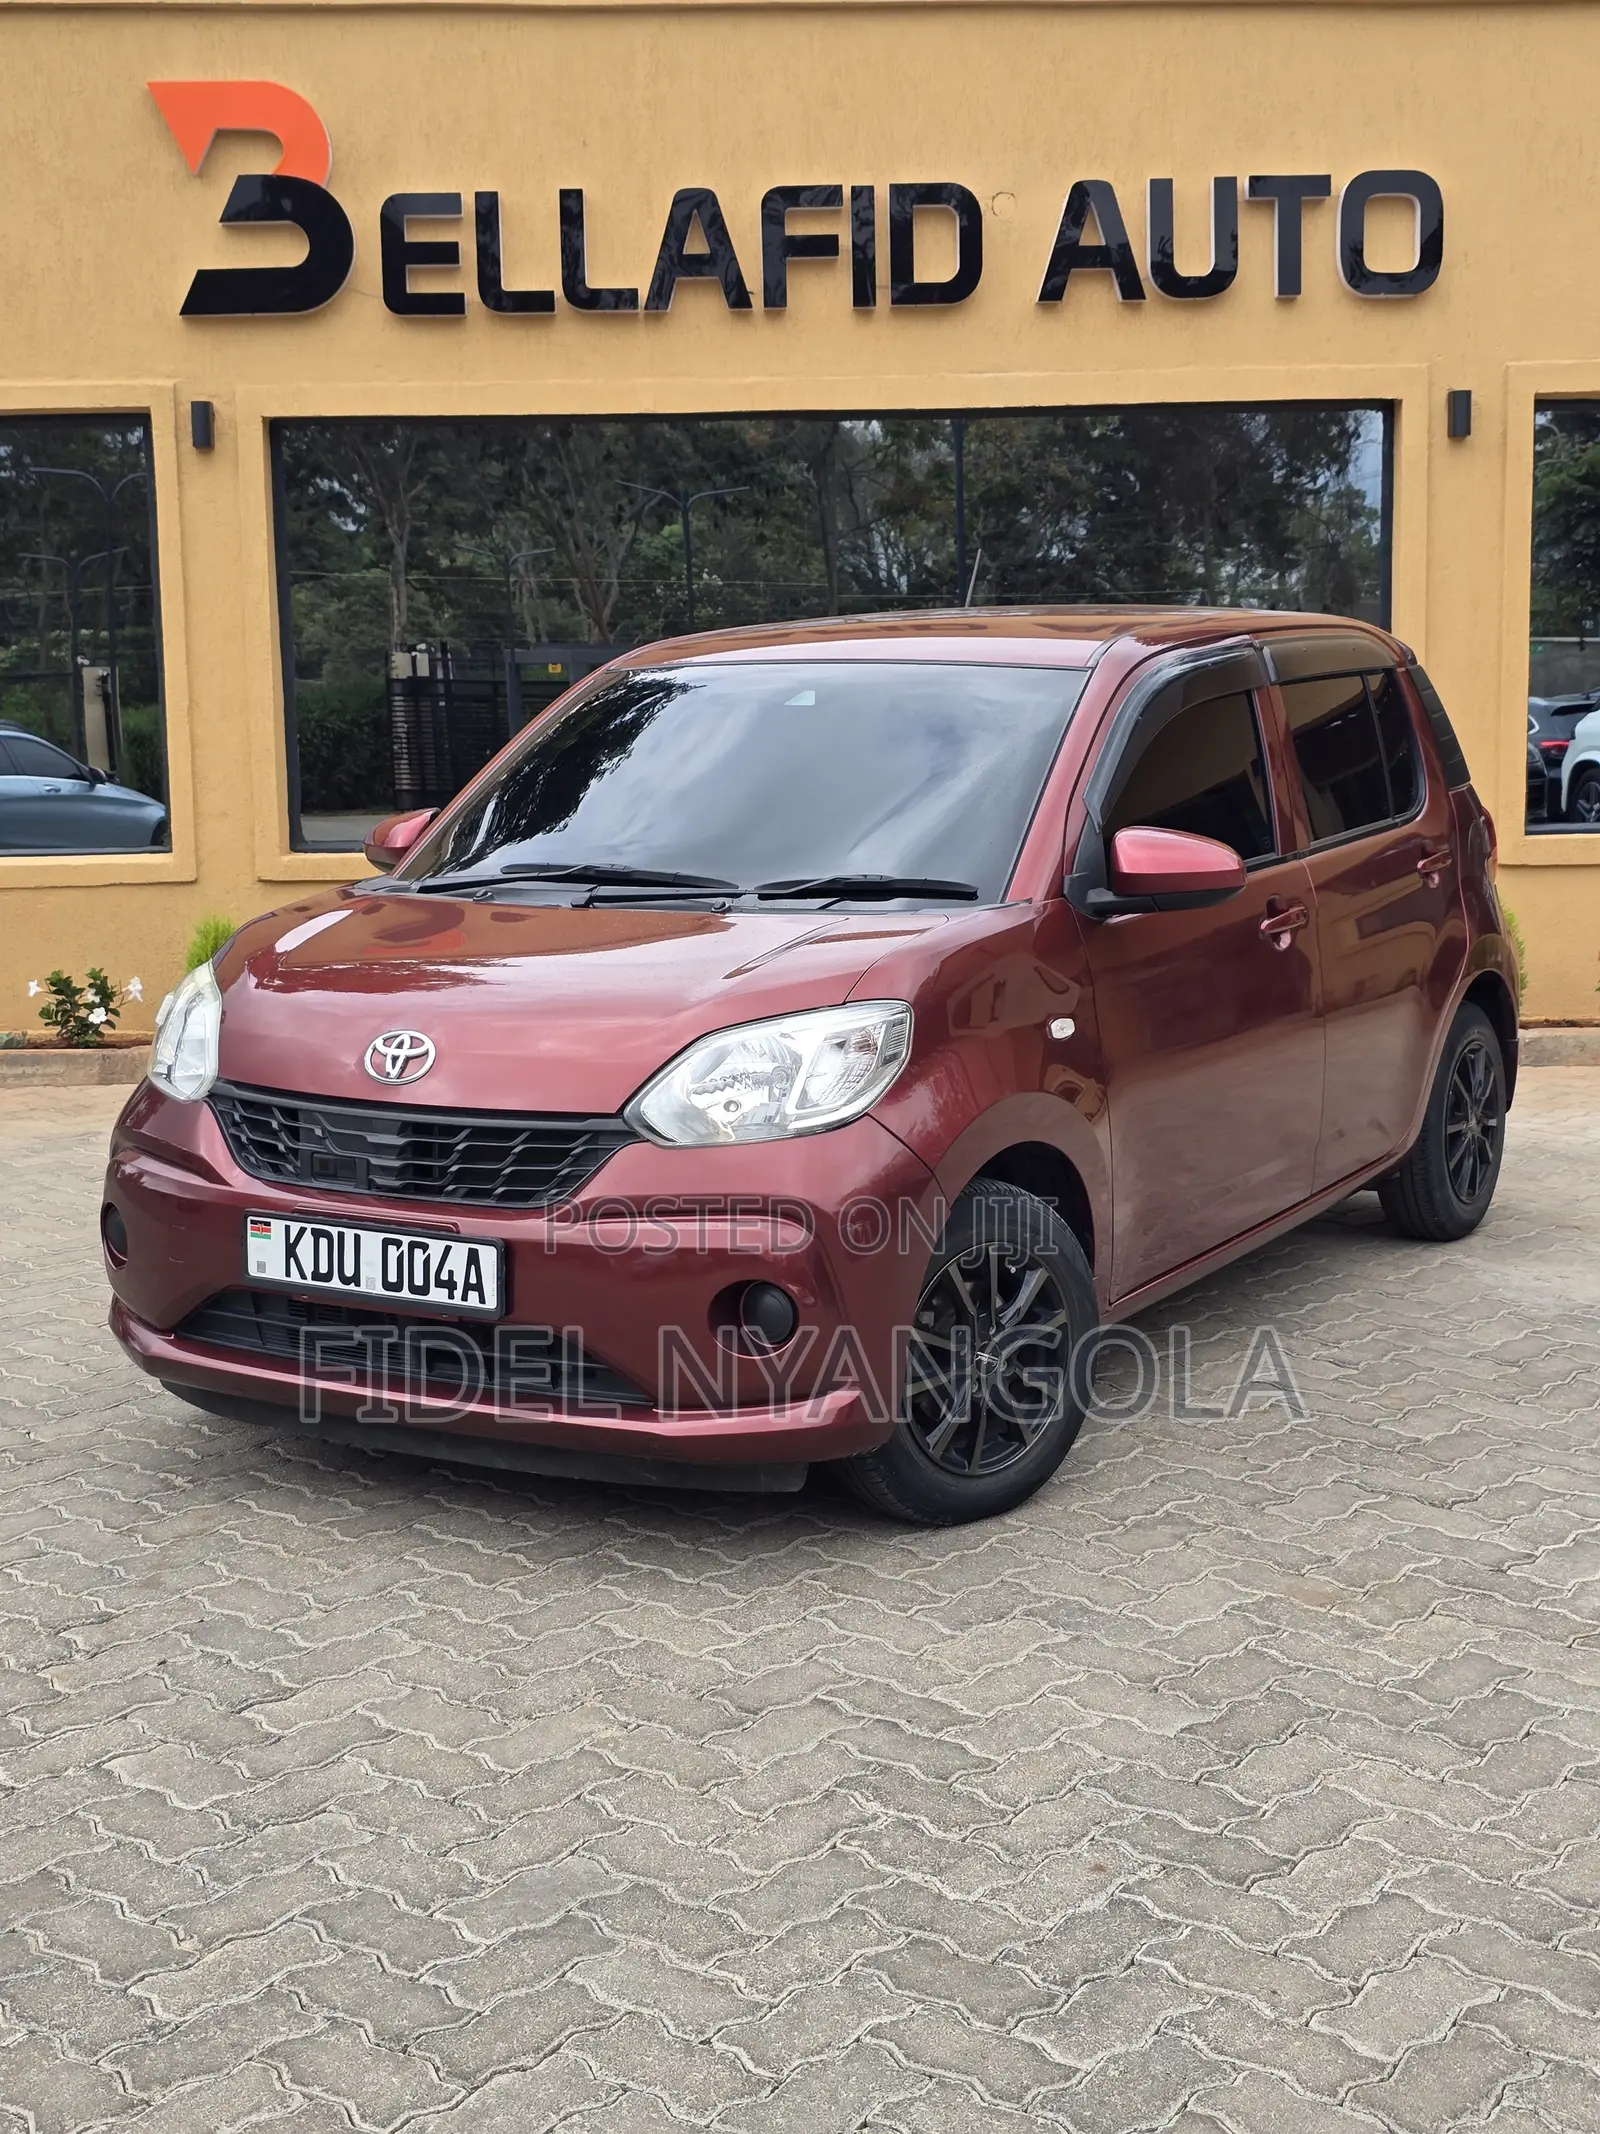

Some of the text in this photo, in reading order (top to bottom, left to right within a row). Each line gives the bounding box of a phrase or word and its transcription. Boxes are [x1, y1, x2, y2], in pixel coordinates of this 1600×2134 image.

[147, 80, 1444, 319] BELLAFID AUTO
[284, 1224, 362, 1288] KDU
[381, 1236, 487, 1305] 004A
